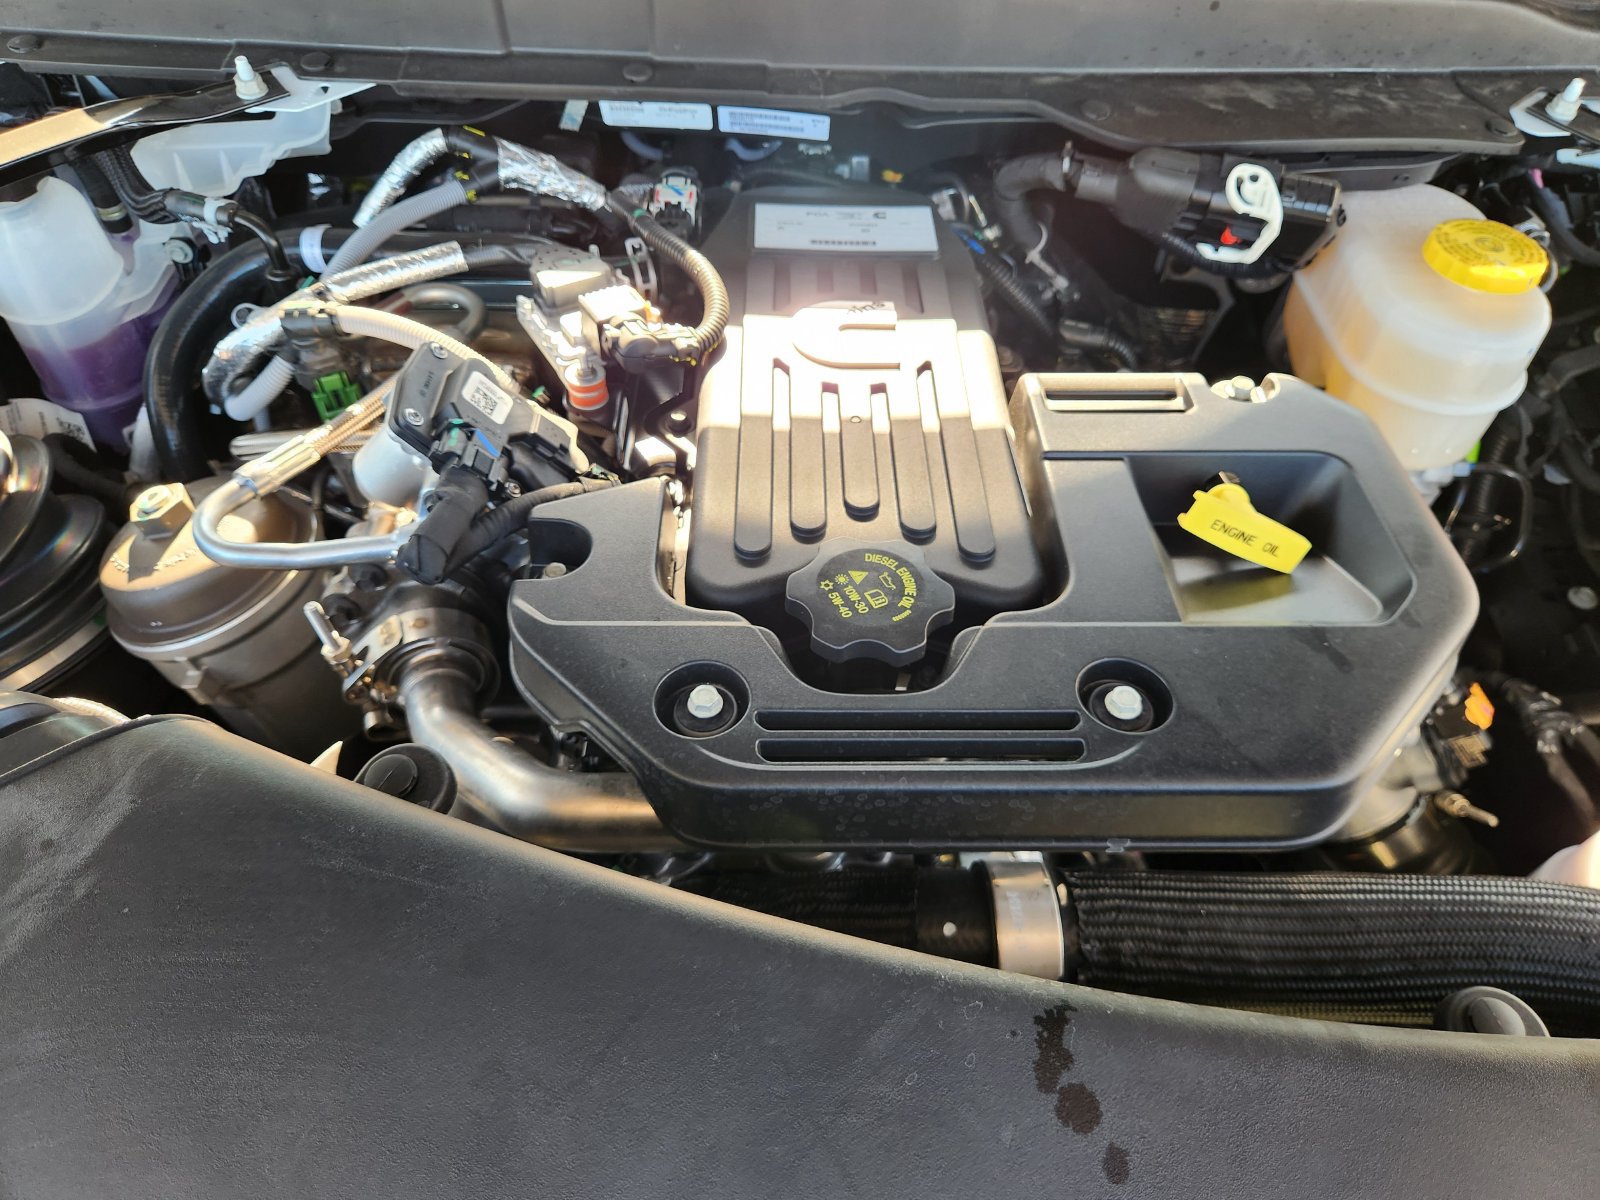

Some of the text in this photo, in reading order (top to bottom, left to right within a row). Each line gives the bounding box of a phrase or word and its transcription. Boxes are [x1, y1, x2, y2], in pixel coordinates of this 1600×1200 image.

[1211, 520, 1280, 557] ENGINE OIL
[865, 553, 898, 570] DIESEL
[896, 567, 917, 596] ENGINE
[828, 591, 852, 618] 5W-40
[843, 585, 869, 614] 10W-30
[898, 597, 914, 609] OIL
